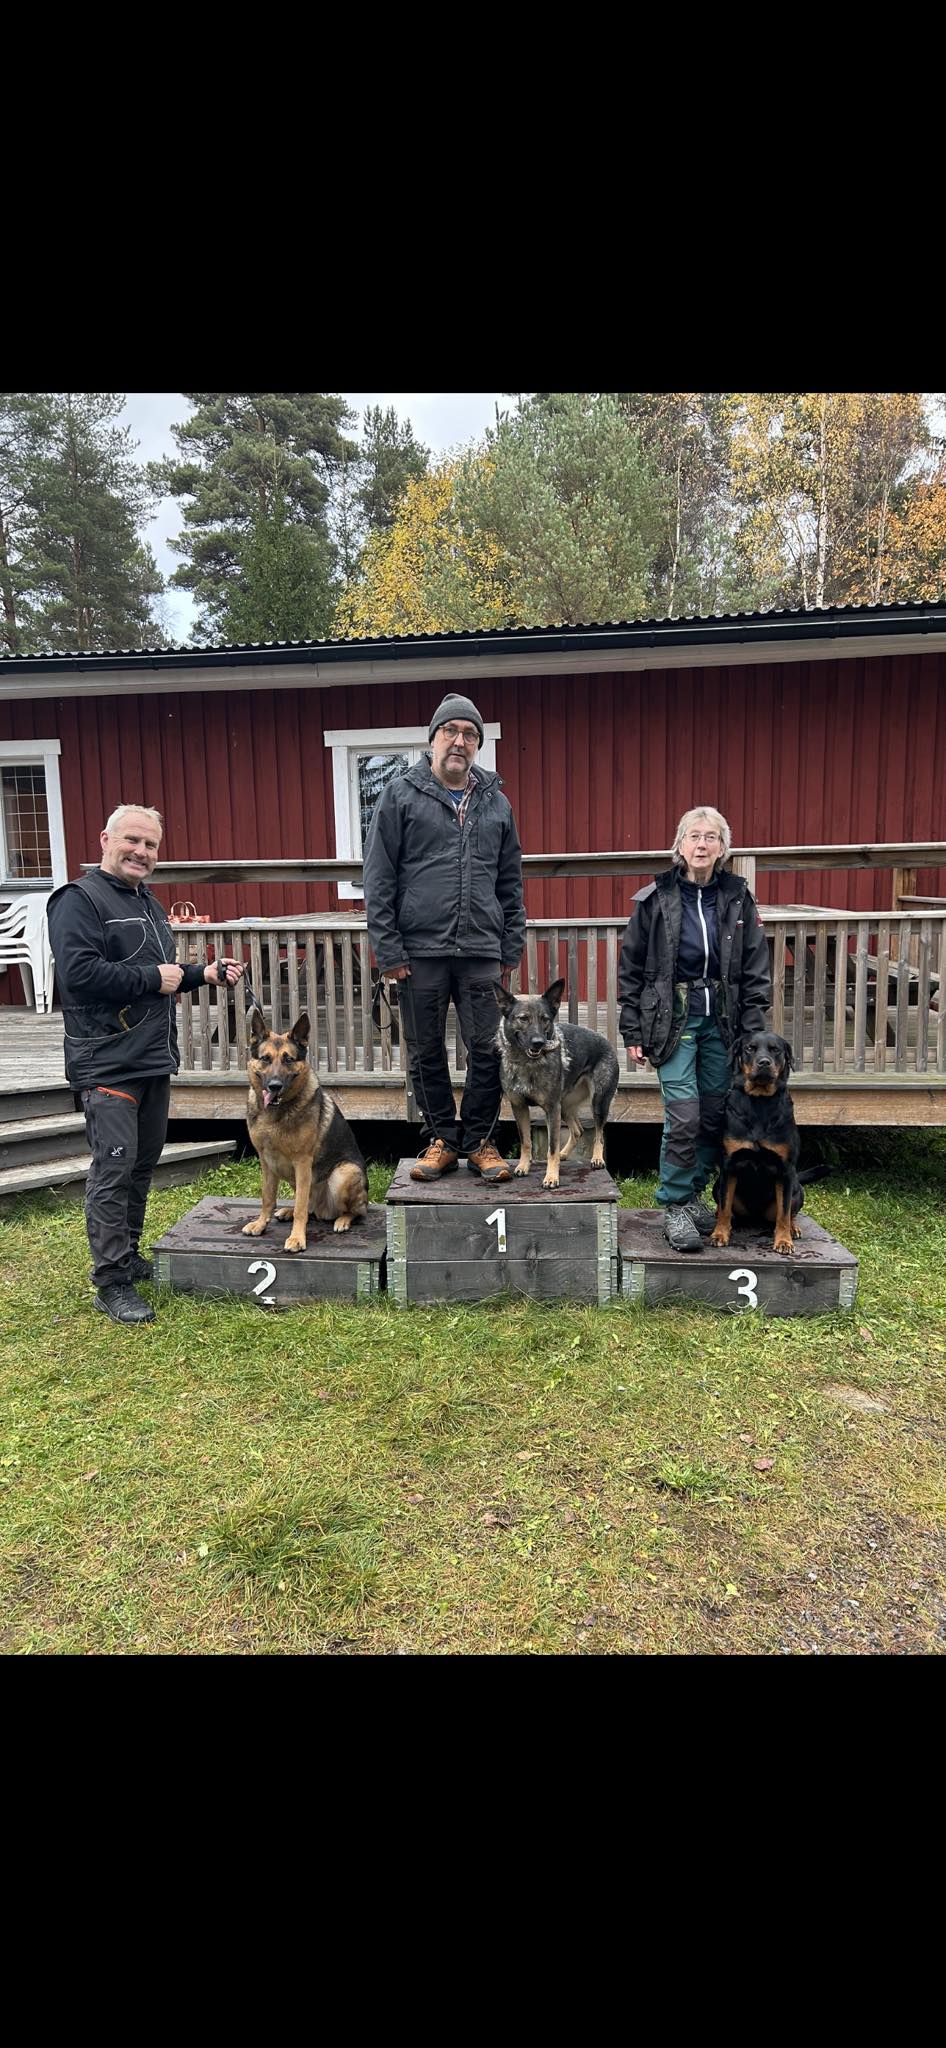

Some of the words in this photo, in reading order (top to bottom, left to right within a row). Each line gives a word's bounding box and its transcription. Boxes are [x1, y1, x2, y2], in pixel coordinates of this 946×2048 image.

[485, 1208, 506, 1252] 1
[247, 1260, 277, 1304] 2
[727, 1269, 758, 1313] 3
